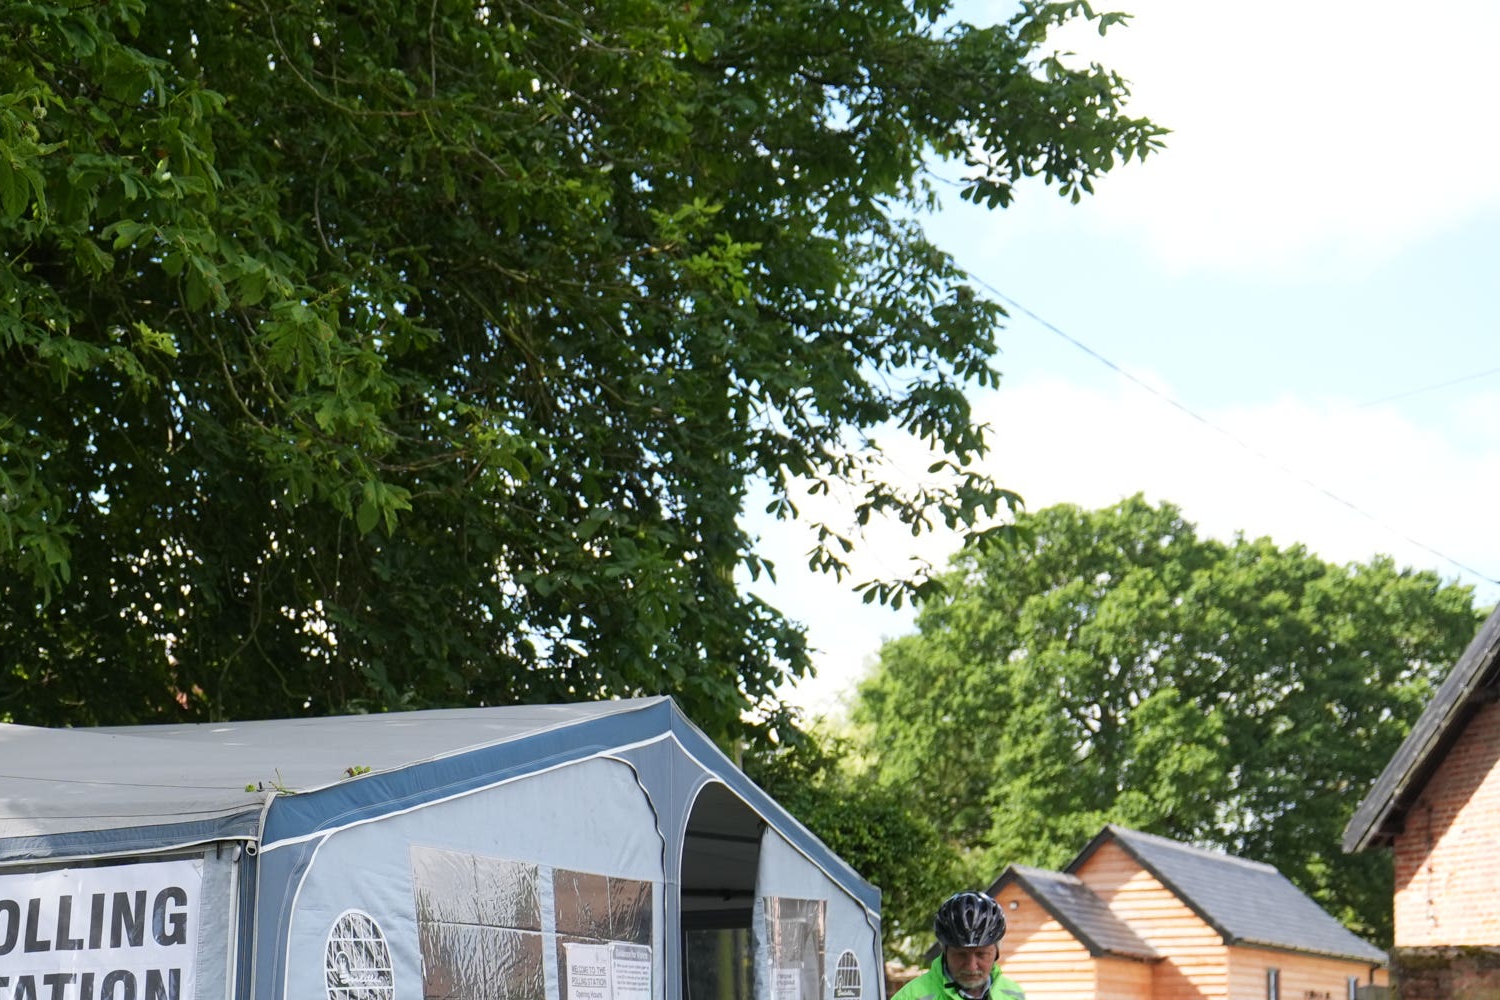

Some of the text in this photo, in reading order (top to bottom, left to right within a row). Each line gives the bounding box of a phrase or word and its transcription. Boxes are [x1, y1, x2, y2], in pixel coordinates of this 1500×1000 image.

[589, 966, 595, 974] TO
[596, 967, 606, 975] THE
[587, 978, 607, 986] STATION
